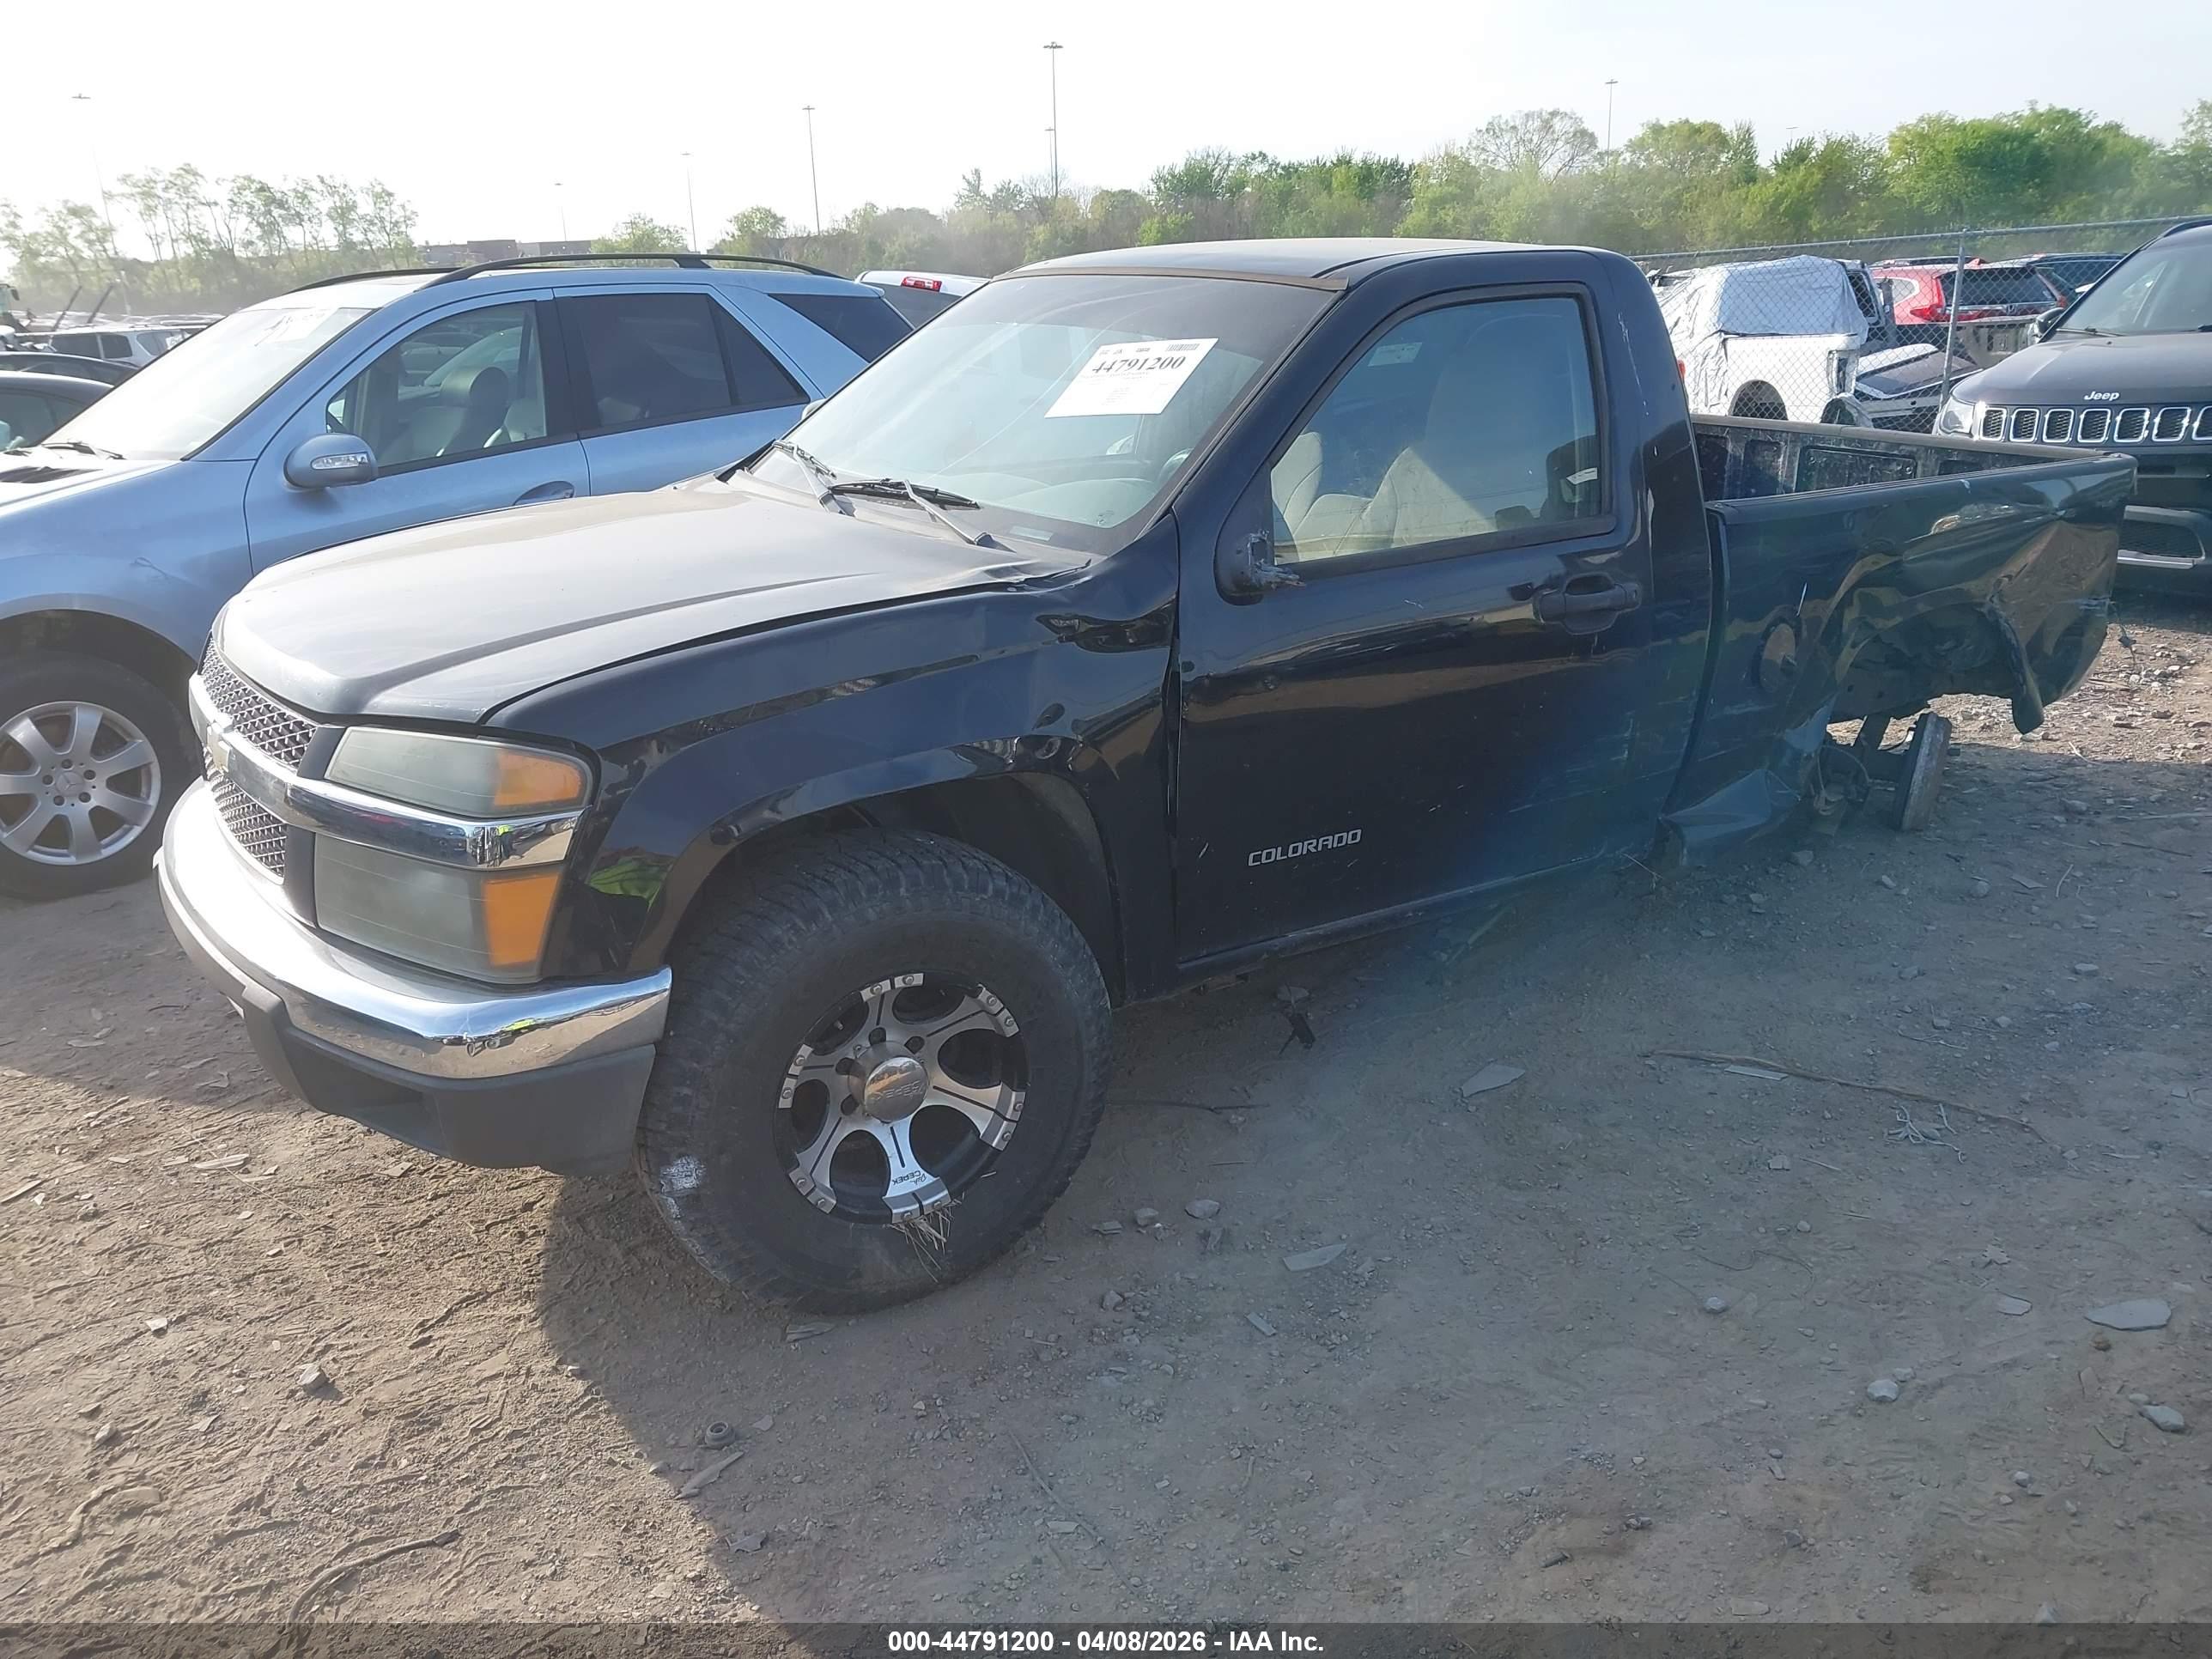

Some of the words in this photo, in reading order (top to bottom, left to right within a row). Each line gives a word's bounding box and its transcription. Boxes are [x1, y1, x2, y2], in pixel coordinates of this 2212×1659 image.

[1092, 356, 1186, 374] 44791200
[2084, 392, 2119, 401] Jeep
[1248, 829, 1362, 866] COLORADO
